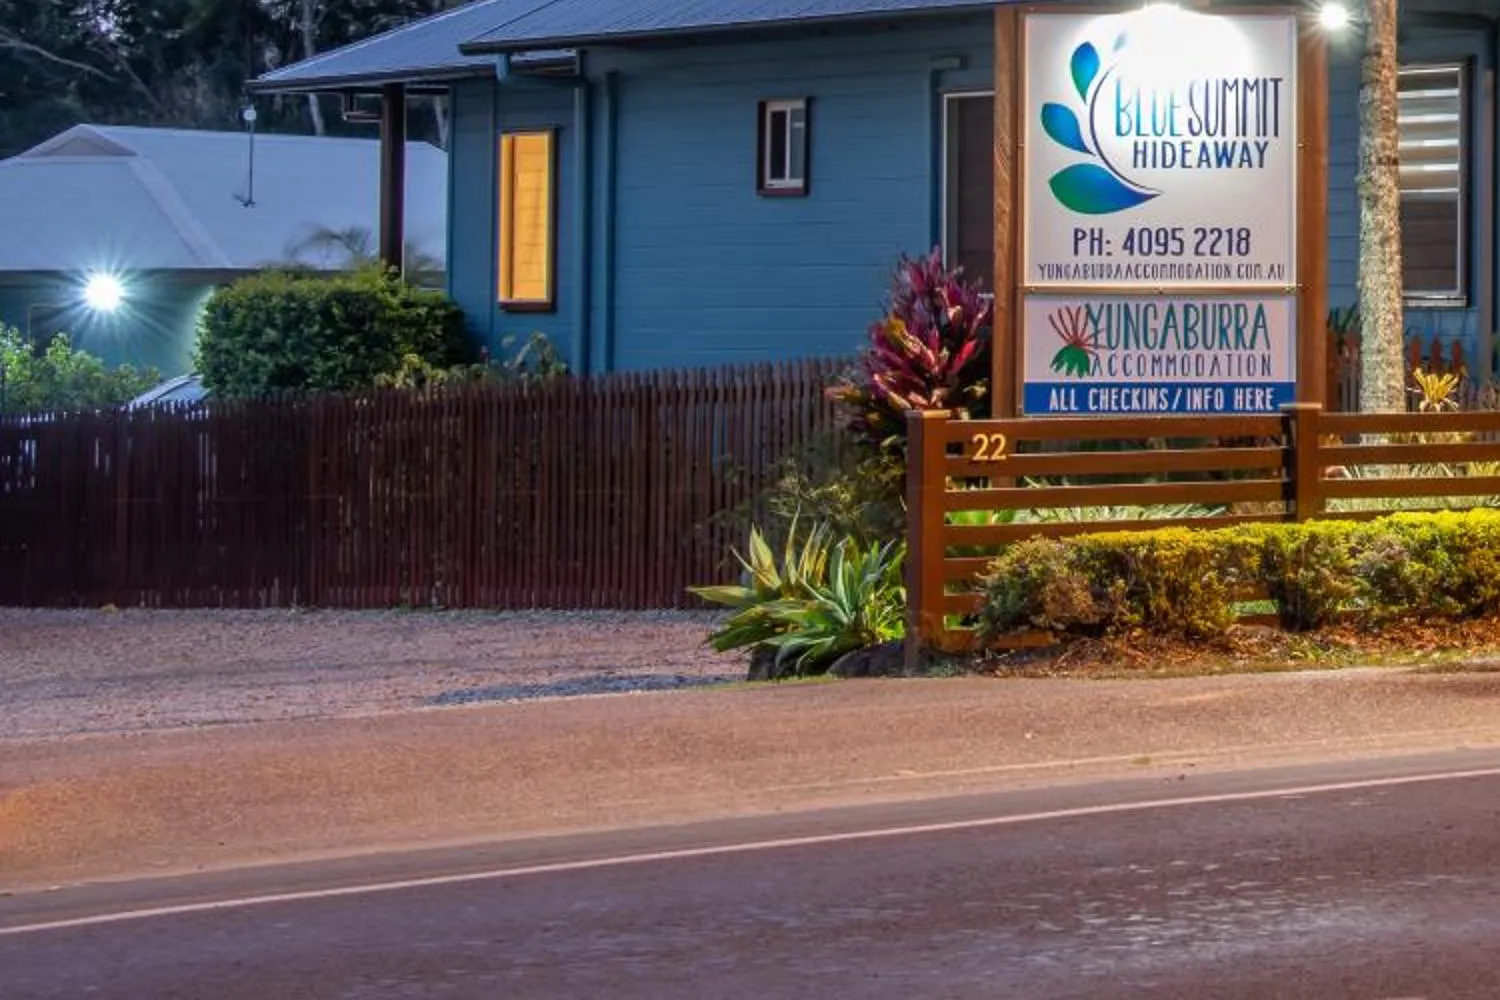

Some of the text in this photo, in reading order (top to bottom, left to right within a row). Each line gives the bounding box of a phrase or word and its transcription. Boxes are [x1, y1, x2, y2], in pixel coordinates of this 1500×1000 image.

[1132, 140, 1269, 169] HIDEAWAY
[1072, 227, 1251, 257] PH: 4095 2218
[1084, 302, 1271, 350] YUNGABURRA
[1091, 353, 1272, 377] ACCOMMODATION
[1049, 388, 1078, 411] ALL
[1233, 387, 1275, 411] HERE
[971, 433, 1007, 461] 22
